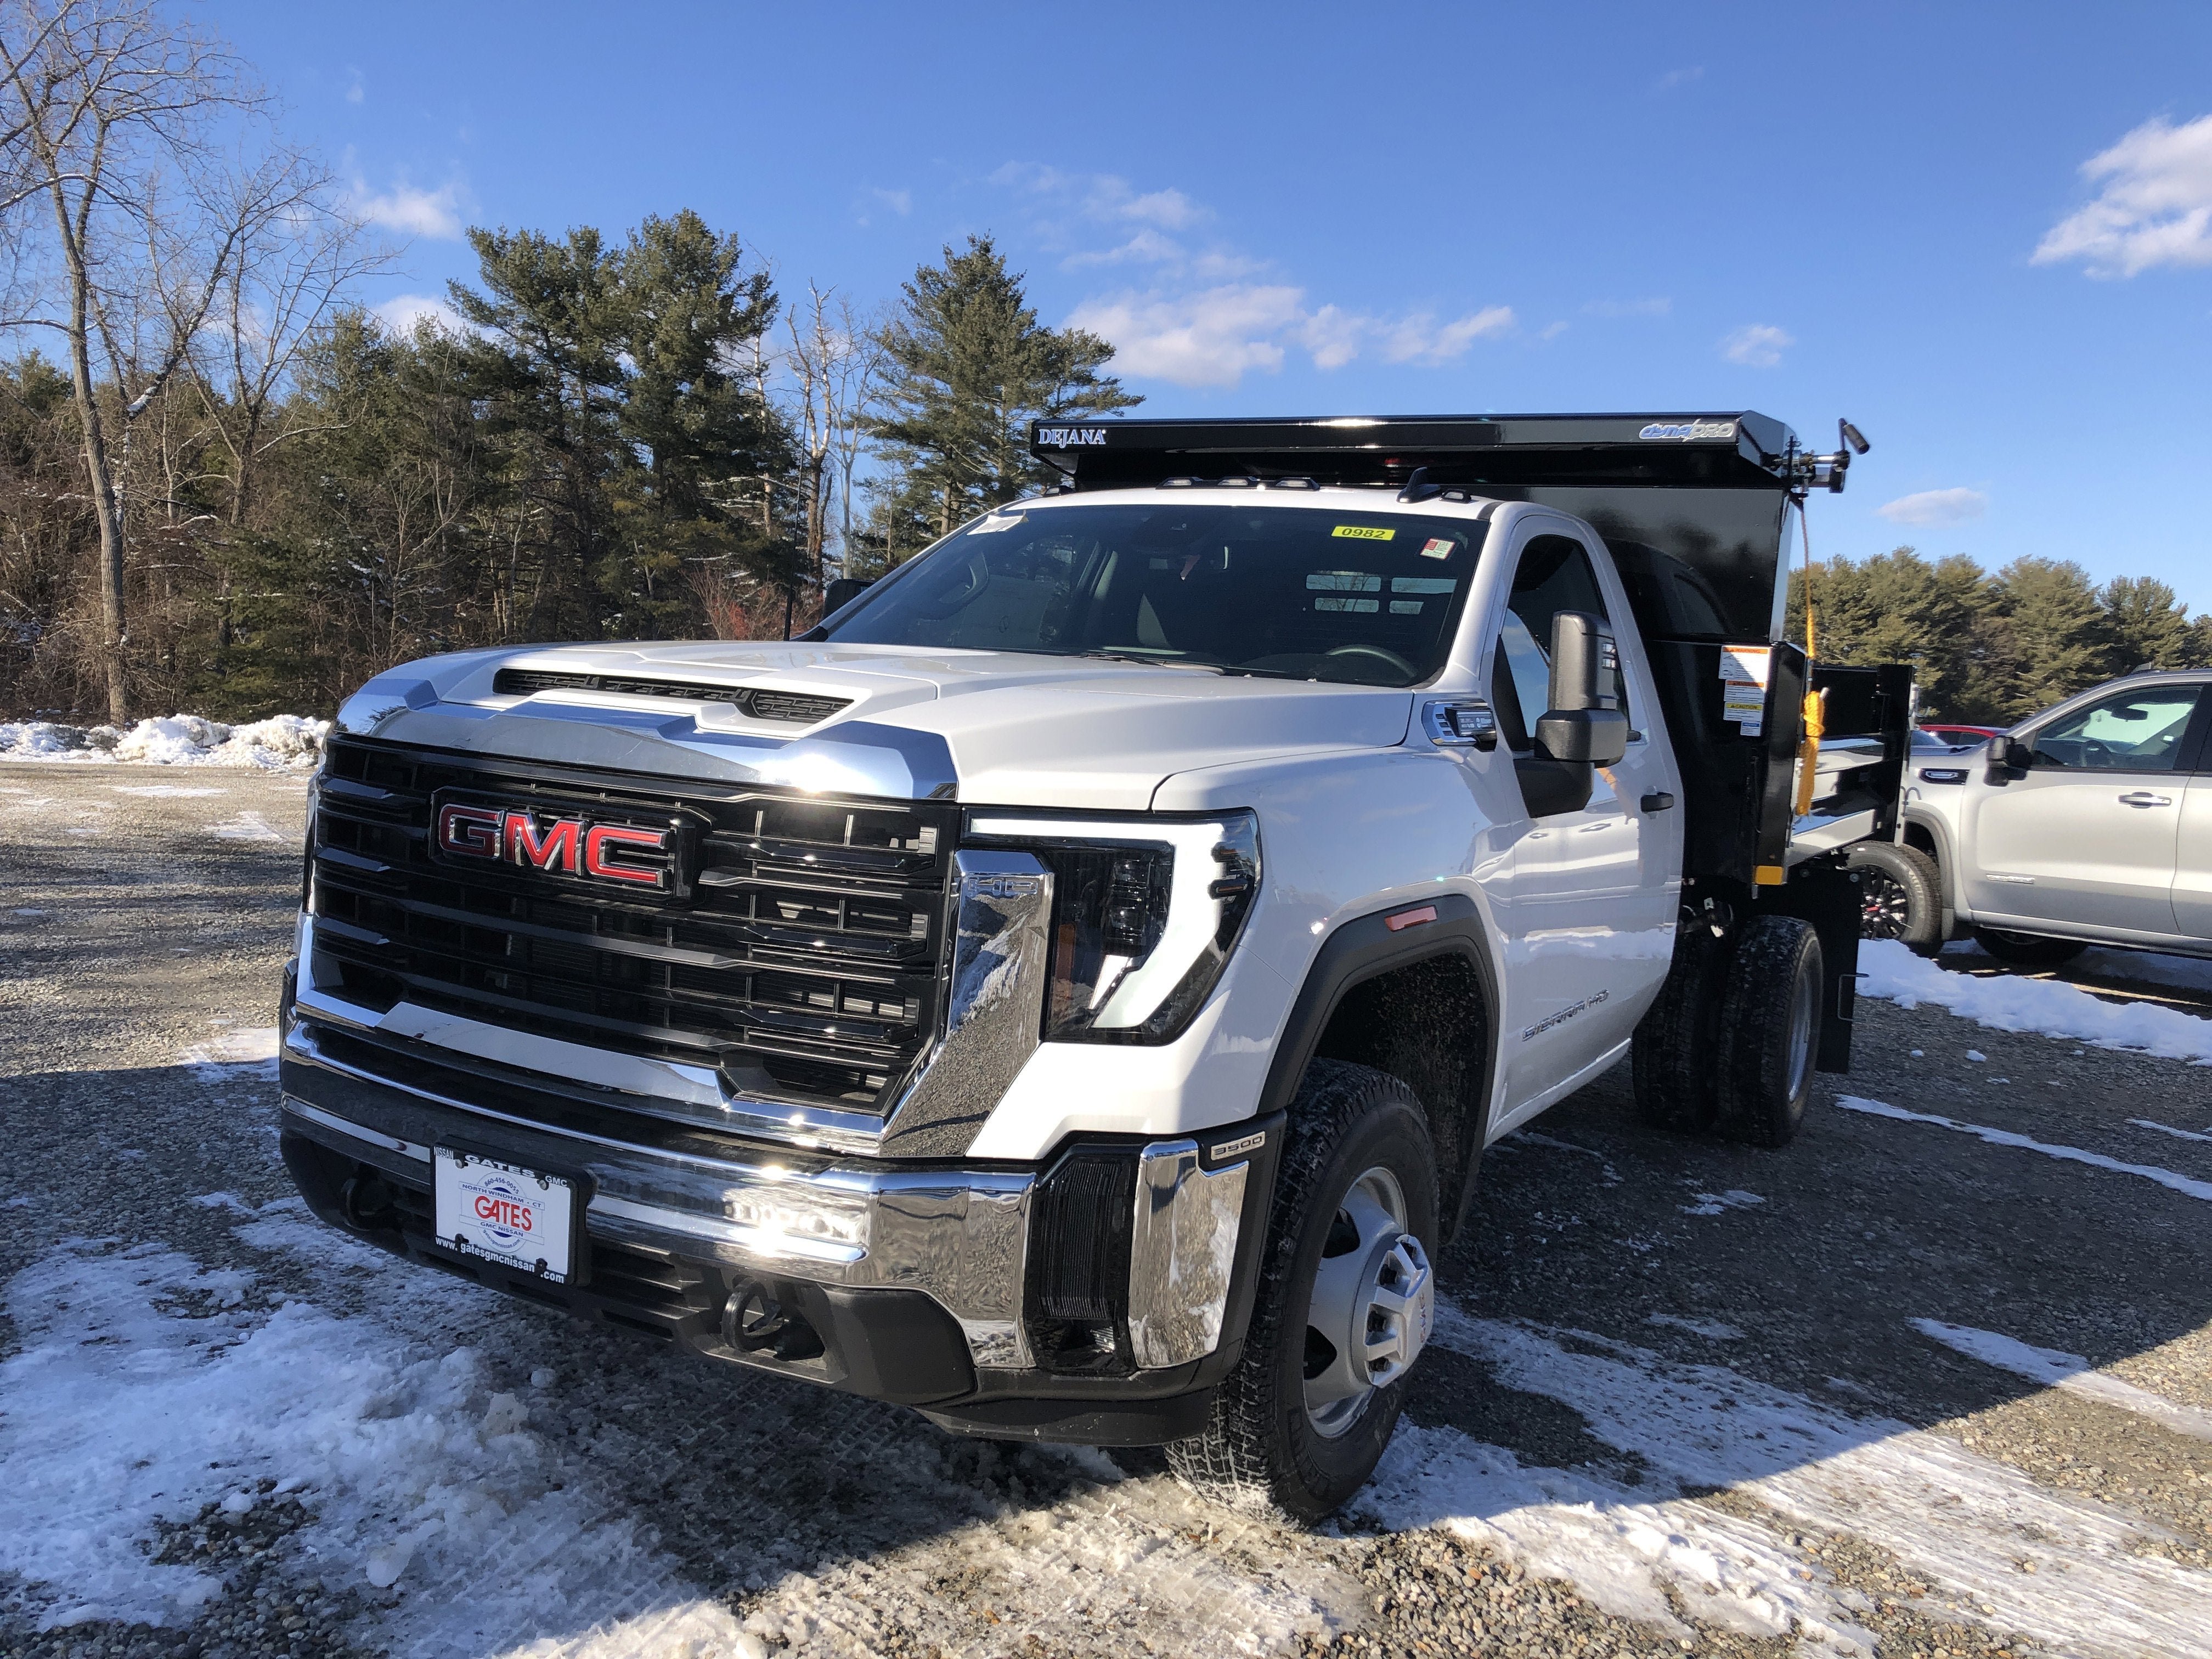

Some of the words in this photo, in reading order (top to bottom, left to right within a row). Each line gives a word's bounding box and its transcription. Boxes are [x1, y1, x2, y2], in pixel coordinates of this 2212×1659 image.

[1038, 429, 1106, 448] DEJANA
[1341, 528, 1385, 539] 0982
[439, 803, 672, 888] GMC
[434, 1146, 454, 1160] NISSAN
[1215, 1136, 1262, 1155] 3500
[465, 1155, 535, 1177] GATES
[545, 1176, 567, 1187] GMC
[462, 1184, 487, 1194] NORTH
[488, 1190, 524, 1203] WINDHAM
[475, 1195, 532, 1232] GATES
[498, 1226, 523, 1237] NISSAN
